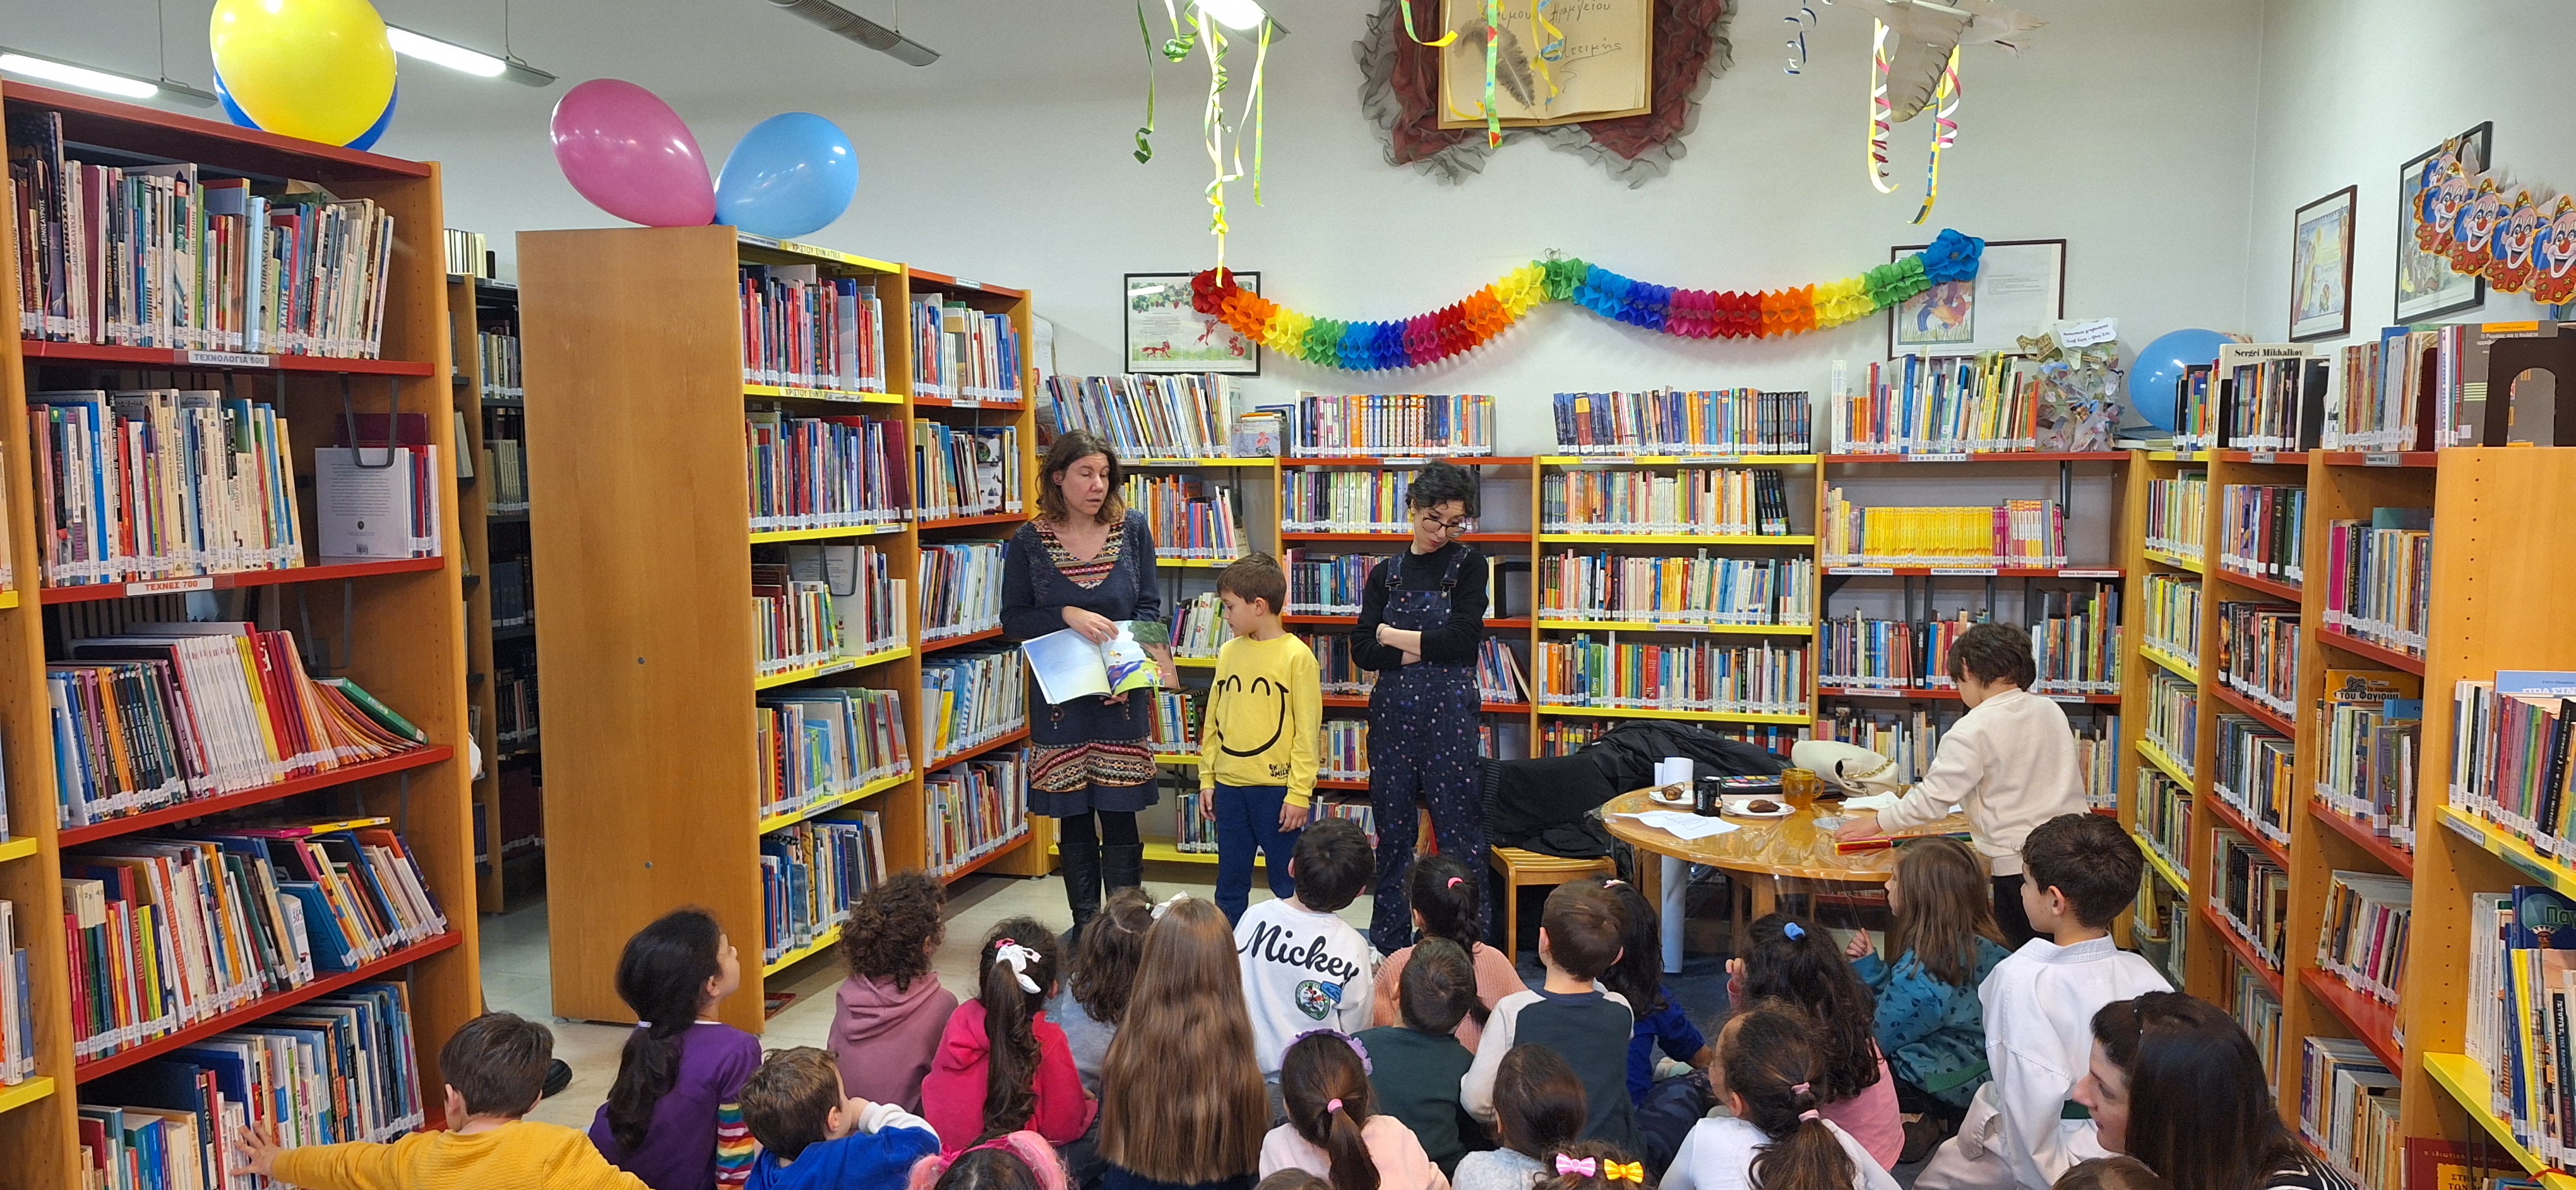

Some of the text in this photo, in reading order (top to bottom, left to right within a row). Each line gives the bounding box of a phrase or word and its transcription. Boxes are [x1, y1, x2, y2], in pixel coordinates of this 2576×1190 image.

[39, 199, 47, 246] ΔΕΙΝΟΣΑΥΡΟΥΣ
[61, 171, 71, 263] ΔΕΙΝΟΣΑΥΡΟΙ
[177, 224, 184, 232] Τα
[280, 288, 289, 325] ΜΑΤΙΕΣ
[194, 354, 265, 364] ΤΕΧΝΟΛΟΓΙΑ 600
[2234, 348, 2304, 358] Sergei Mikhalkov
[145, 580, 198, 591] ΤΕΧΝΕΣ 700
[2340, 692, 2356, 700] του
[1270, 769, 1289, 778] SMILE
[292, 908, 303, 923] 365
[132, 910, 145, 980] ΠΑΙΔΙΚΕΣ ΓΙΟΡΤΕΣ
[1237, 920, 1359, 989] Mickey
